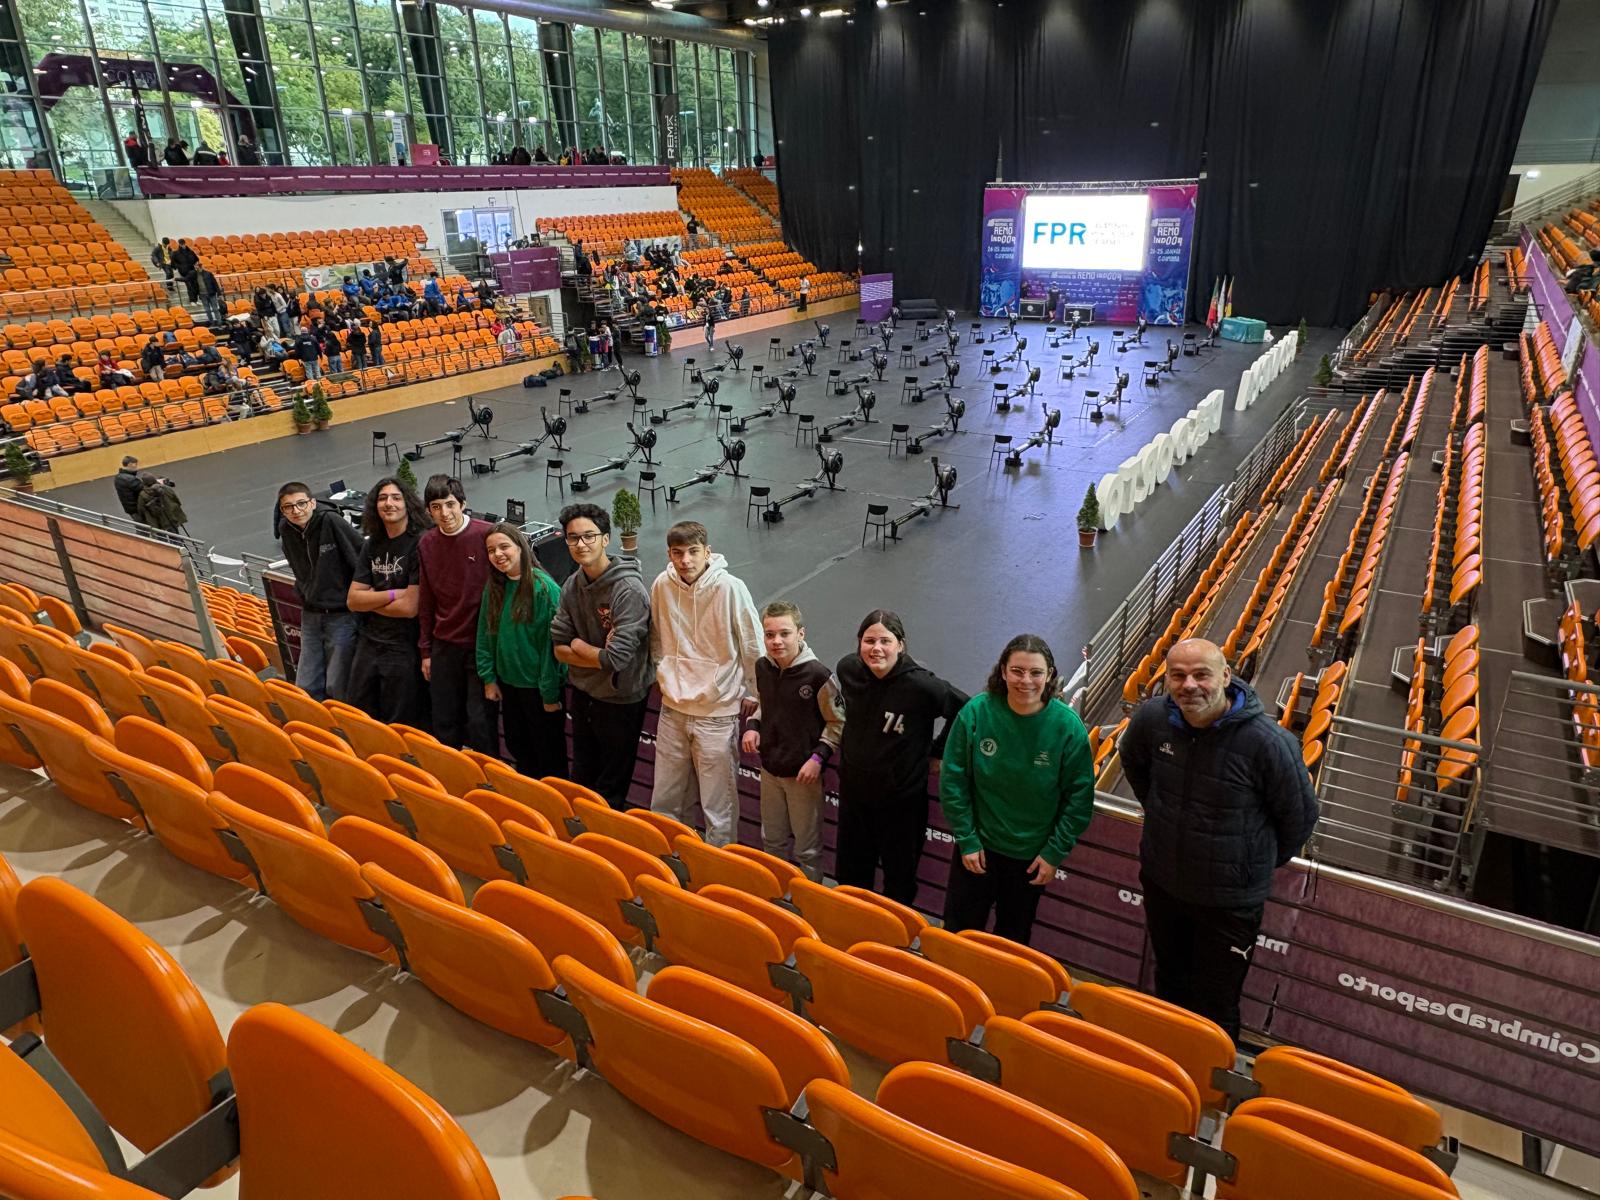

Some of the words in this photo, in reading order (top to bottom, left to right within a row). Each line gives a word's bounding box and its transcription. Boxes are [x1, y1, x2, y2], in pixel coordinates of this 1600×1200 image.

[994, 226, 1013, 235] REMO
[1033, 221, 1087, 245] FPR
[1157, 227, 1180, 237] REMO
[1077, 271, 1096, 280] REMO
[882, 711, 905, 734] 74
